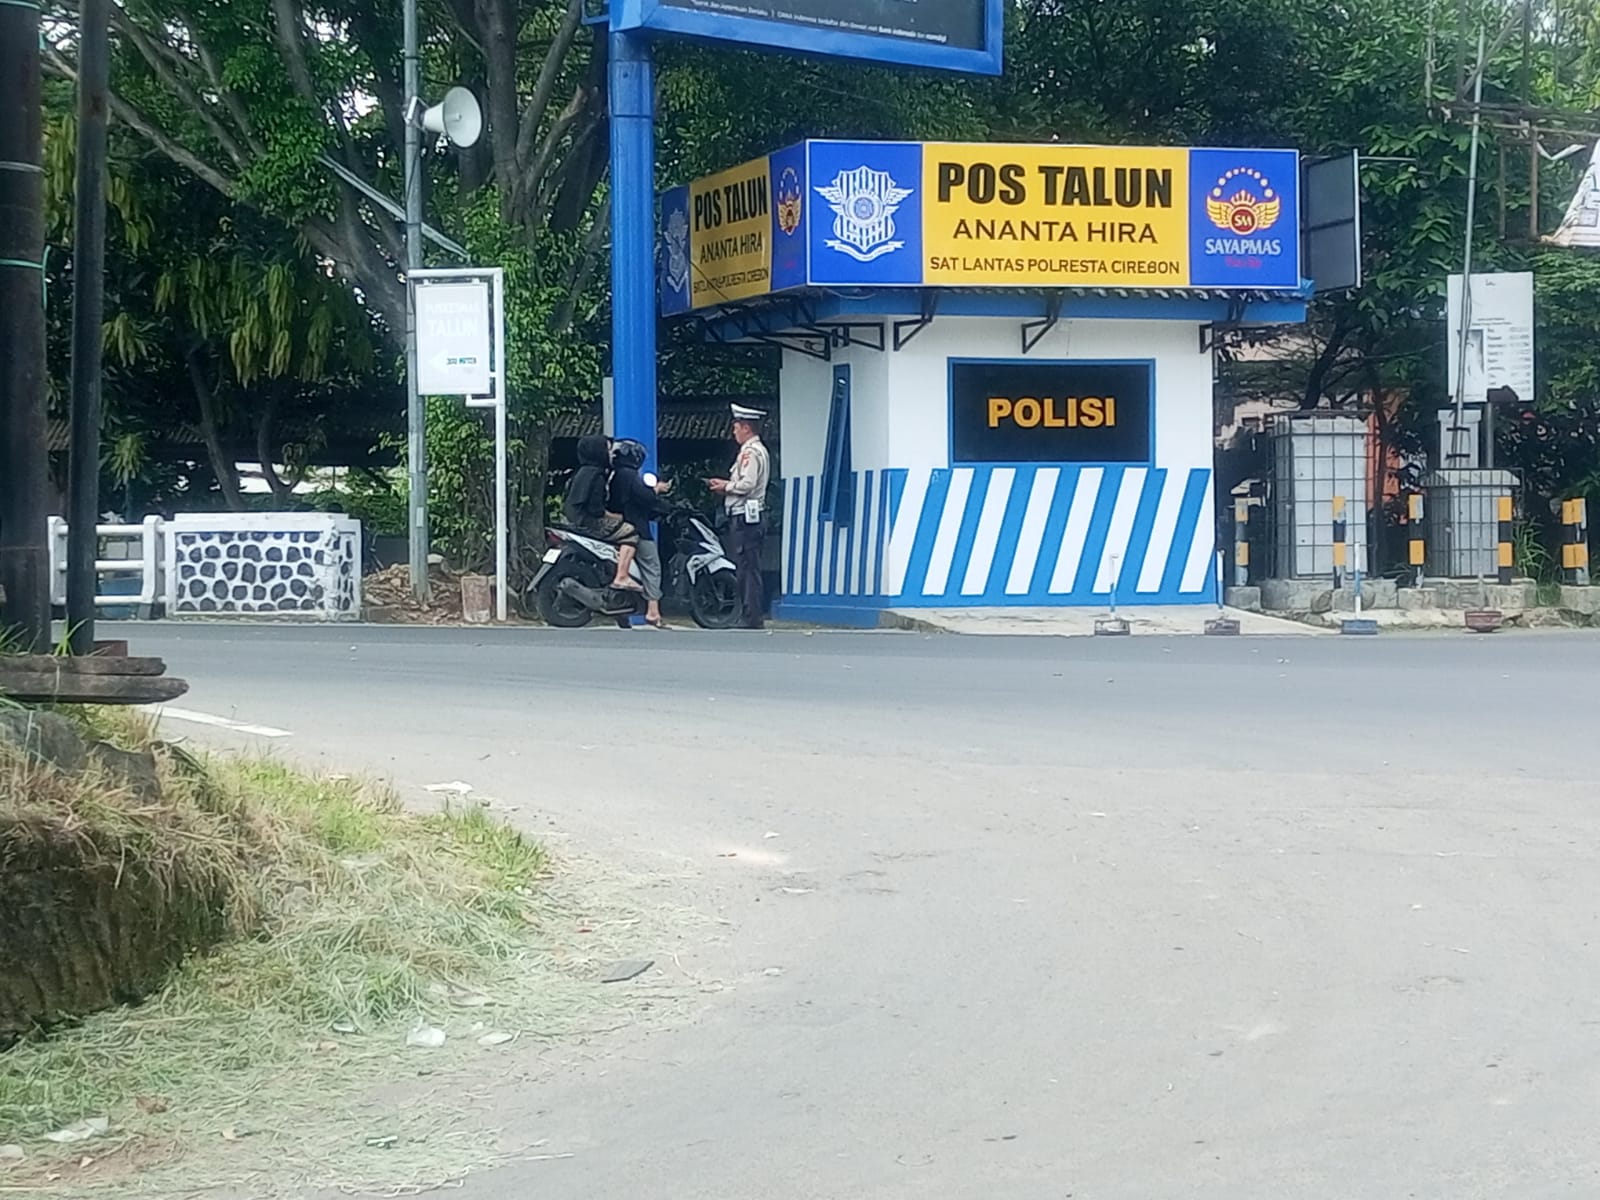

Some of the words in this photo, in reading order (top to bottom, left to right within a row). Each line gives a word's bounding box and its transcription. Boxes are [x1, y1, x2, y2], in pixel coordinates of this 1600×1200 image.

[938, 162, 1026, 205] POS
[1038, 165, 1172, 208] TALUN
[694, 188, 722, 232] POS
[724, 175, 768, 225] TALUN
[953, 218, 1078, 242] ANANTA
[1087, 221, 1158, 244] HIRA
[1205, 238, 1281, 255] SAYAPMAS
[700, 237, 738, 264] ANANTA
[740, 232, 763, 254] HIRA
[930, 256, 959, 271] SAT
[963, 257, 1025, 272] LANTAS
[1028, 259, 1108, 273] POLRESTA
[1111, 260, 1180, 275] CIREBON
[987, 397, 1116, 428] POLISI
